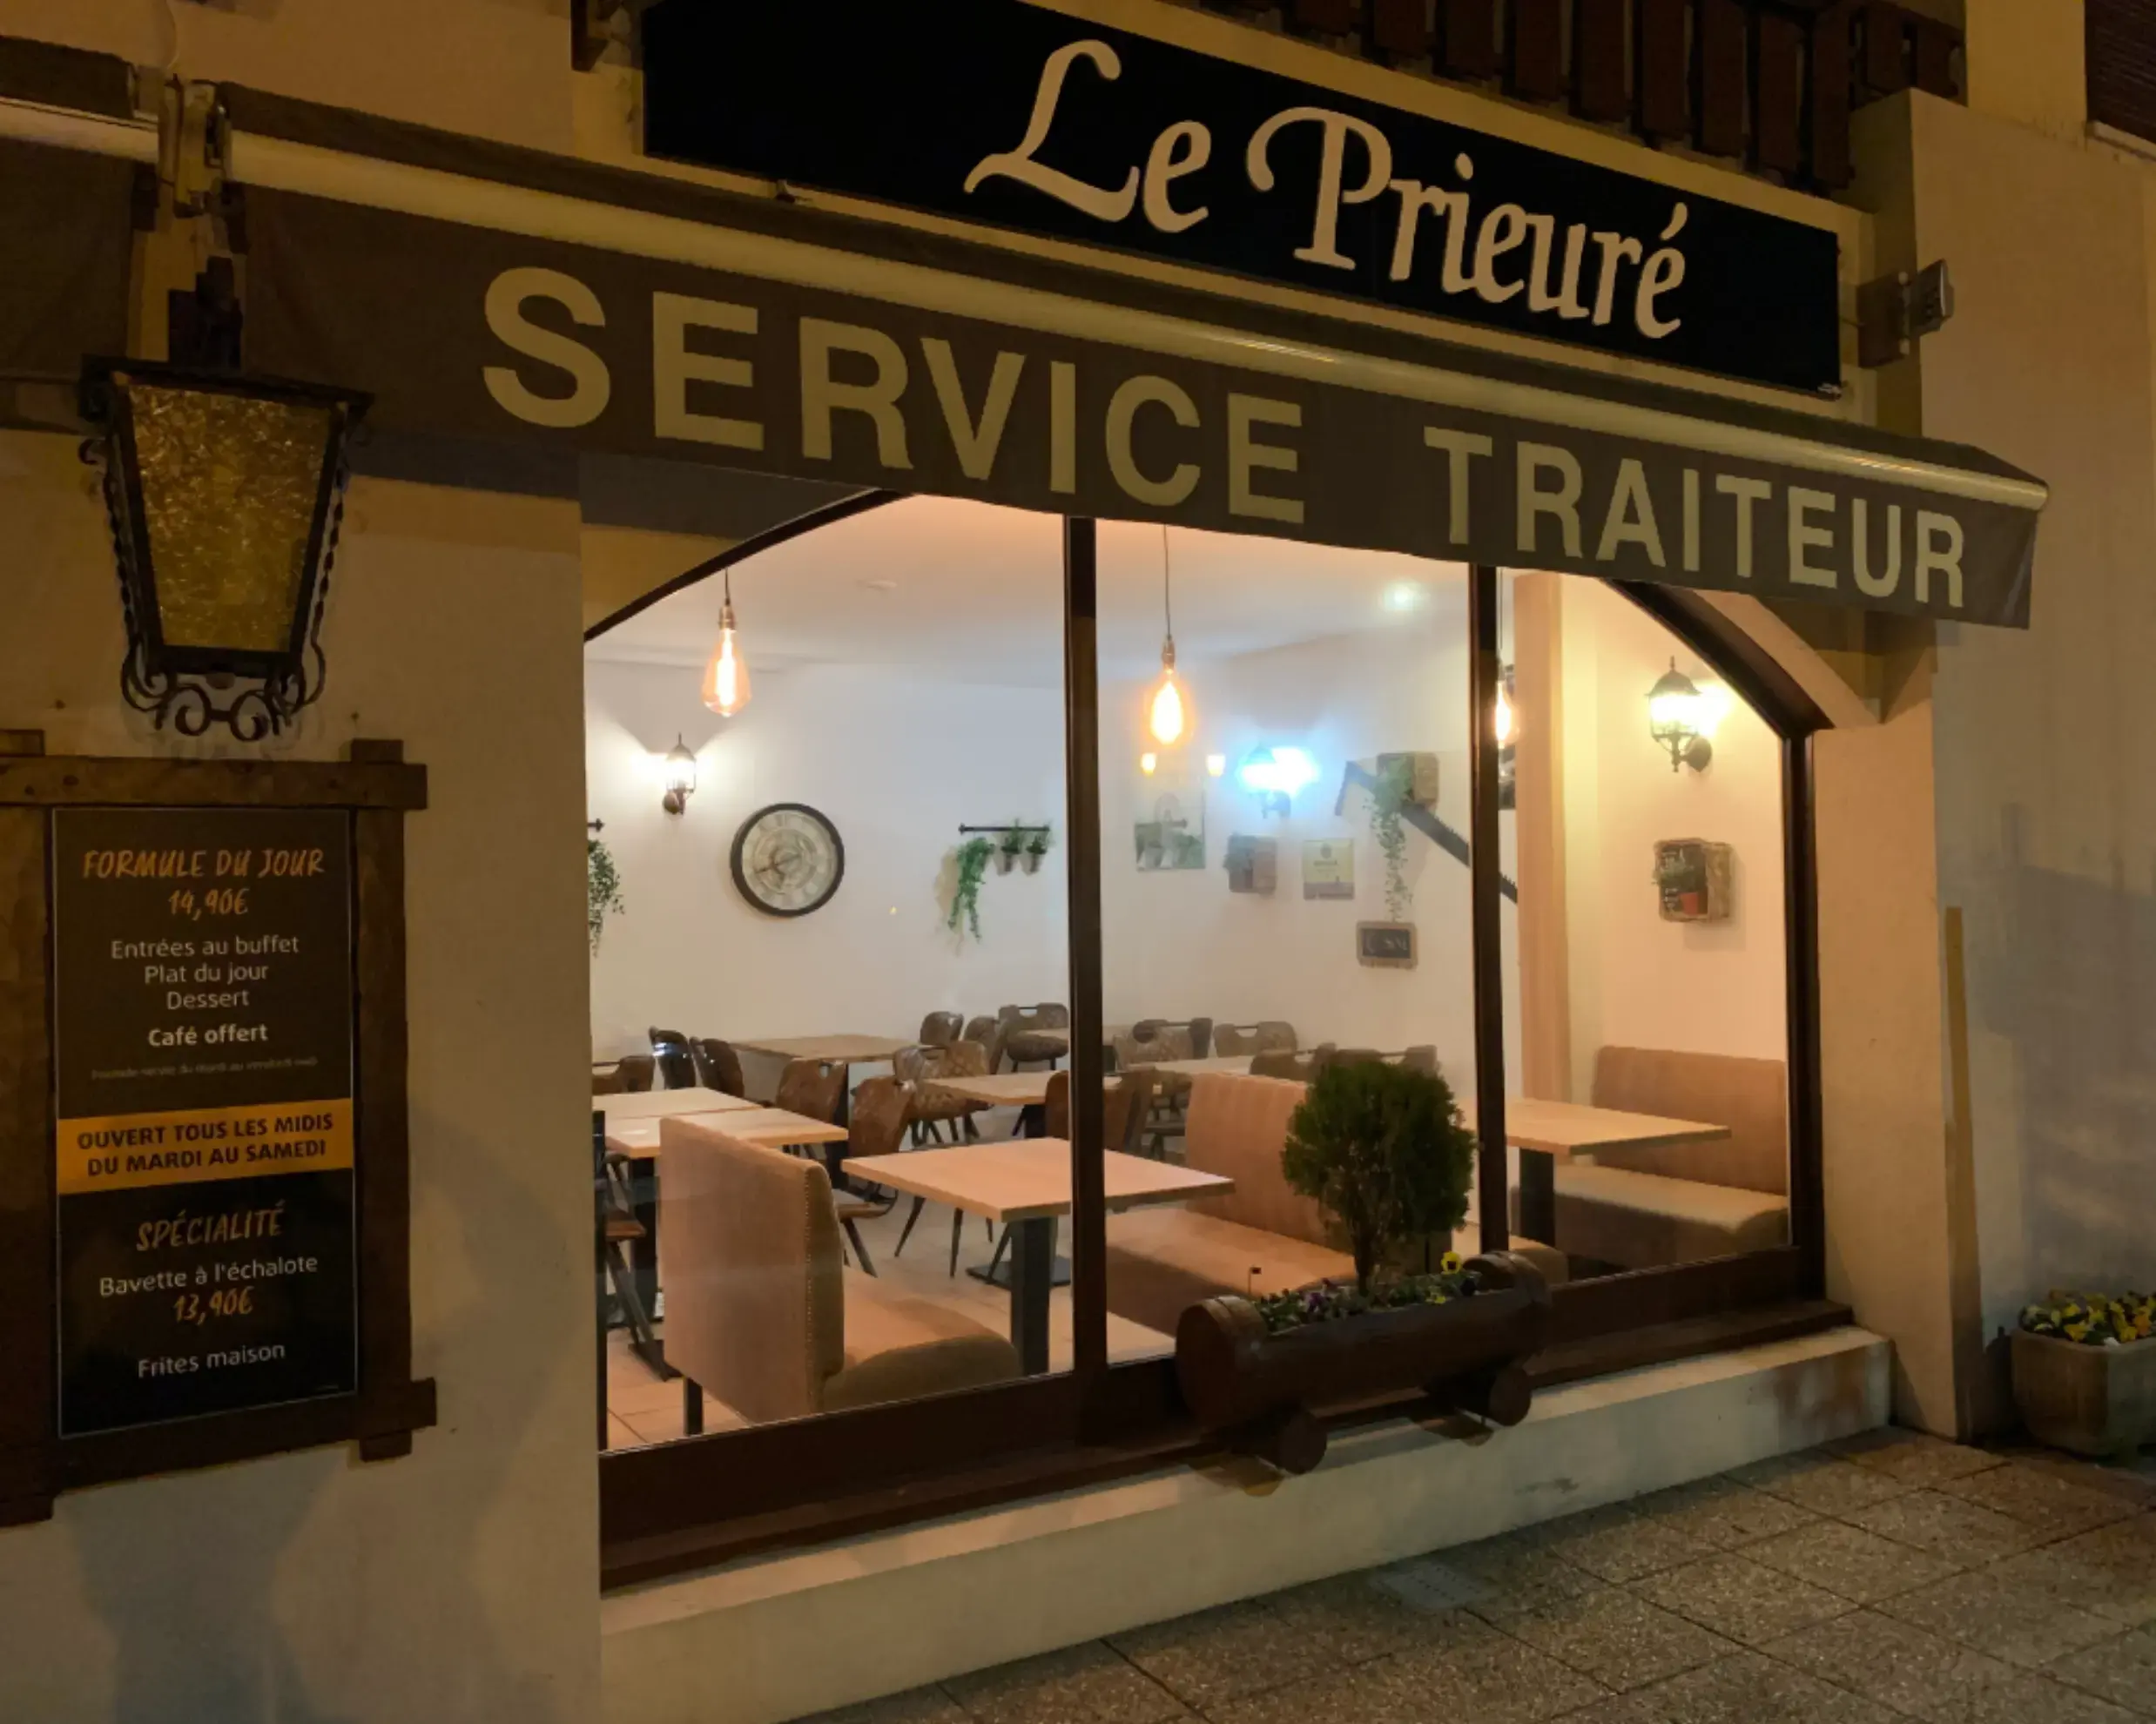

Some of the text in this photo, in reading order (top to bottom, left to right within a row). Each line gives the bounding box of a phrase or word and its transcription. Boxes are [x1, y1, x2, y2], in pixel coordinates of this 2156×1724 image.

[964, 38, 1689, 338] Le Prieuré
[482, 266, 1965, 609] SERVICE TRAITEUR
[82, 848, 326, 879] FORMULE DU JOUR
[168, 888, 250, 920] 14,90€
[111, 934, 300, 960] Entrées au buffet
[144, 962, 269, 985] Plat du jour
[166, 990, 250, 1010] Dessert
[148, 1023, 268, 1047] Café offert
[77, 1113, 333, 1150] OUVERT TOUS LES MIDIS
[88, 1140, 326, 1176] DU MARDI AU SAMEDI
[136, 1199, 285, 1251] SPÉCIALITÉ
[100, 1255, 318, 1297] Bavette à l'échalote
[173, 1286, 254, 1325] 13,90€
[138, 1343, 285, 1378] Frites maison
